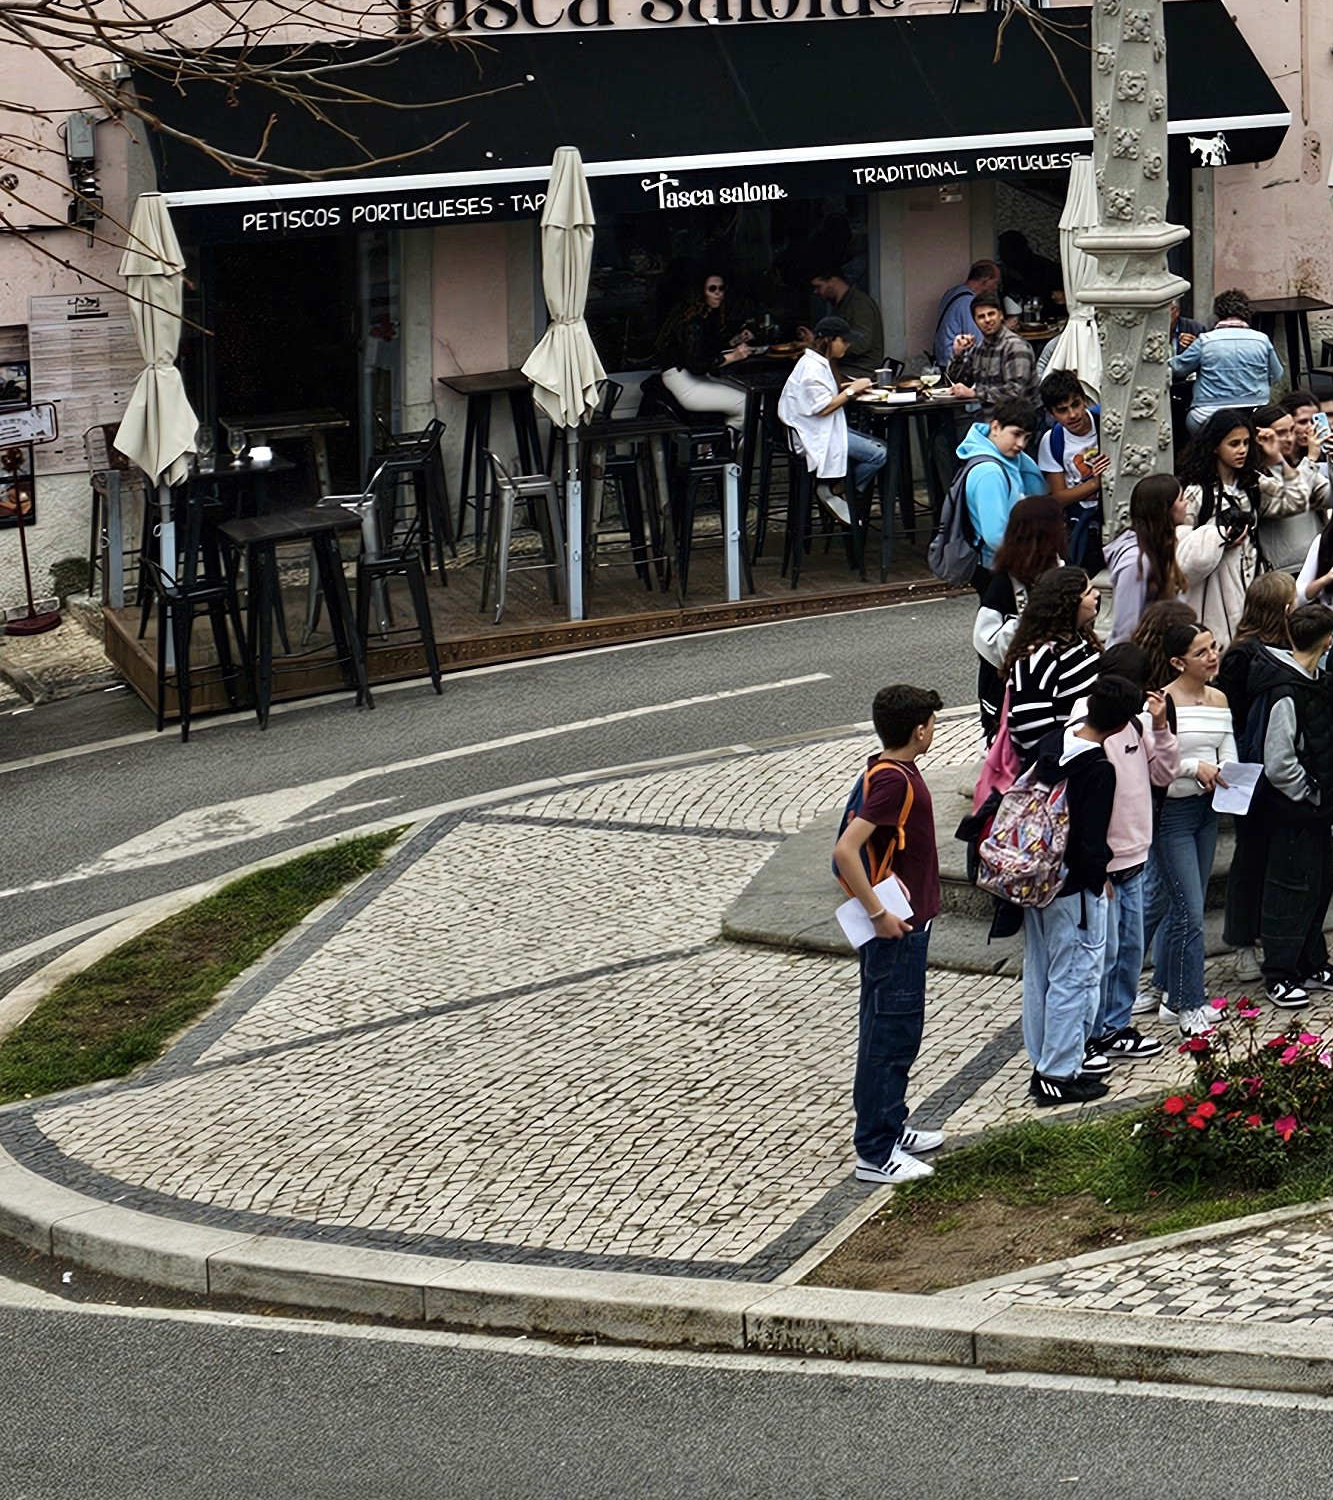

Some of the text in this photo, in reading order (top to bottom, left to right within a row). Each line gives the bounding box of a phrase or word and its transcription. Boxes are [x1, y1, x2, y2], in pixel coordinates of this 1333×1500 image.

[852, 160, 968, 185] TRADITIONAL
[640, 178, 716, 210] Tasca
[241, 207, 341, 232] PETISCOS
[352, 196, 493, 224] PORTUGUESES
[510, 193, 547, 213] TAP
